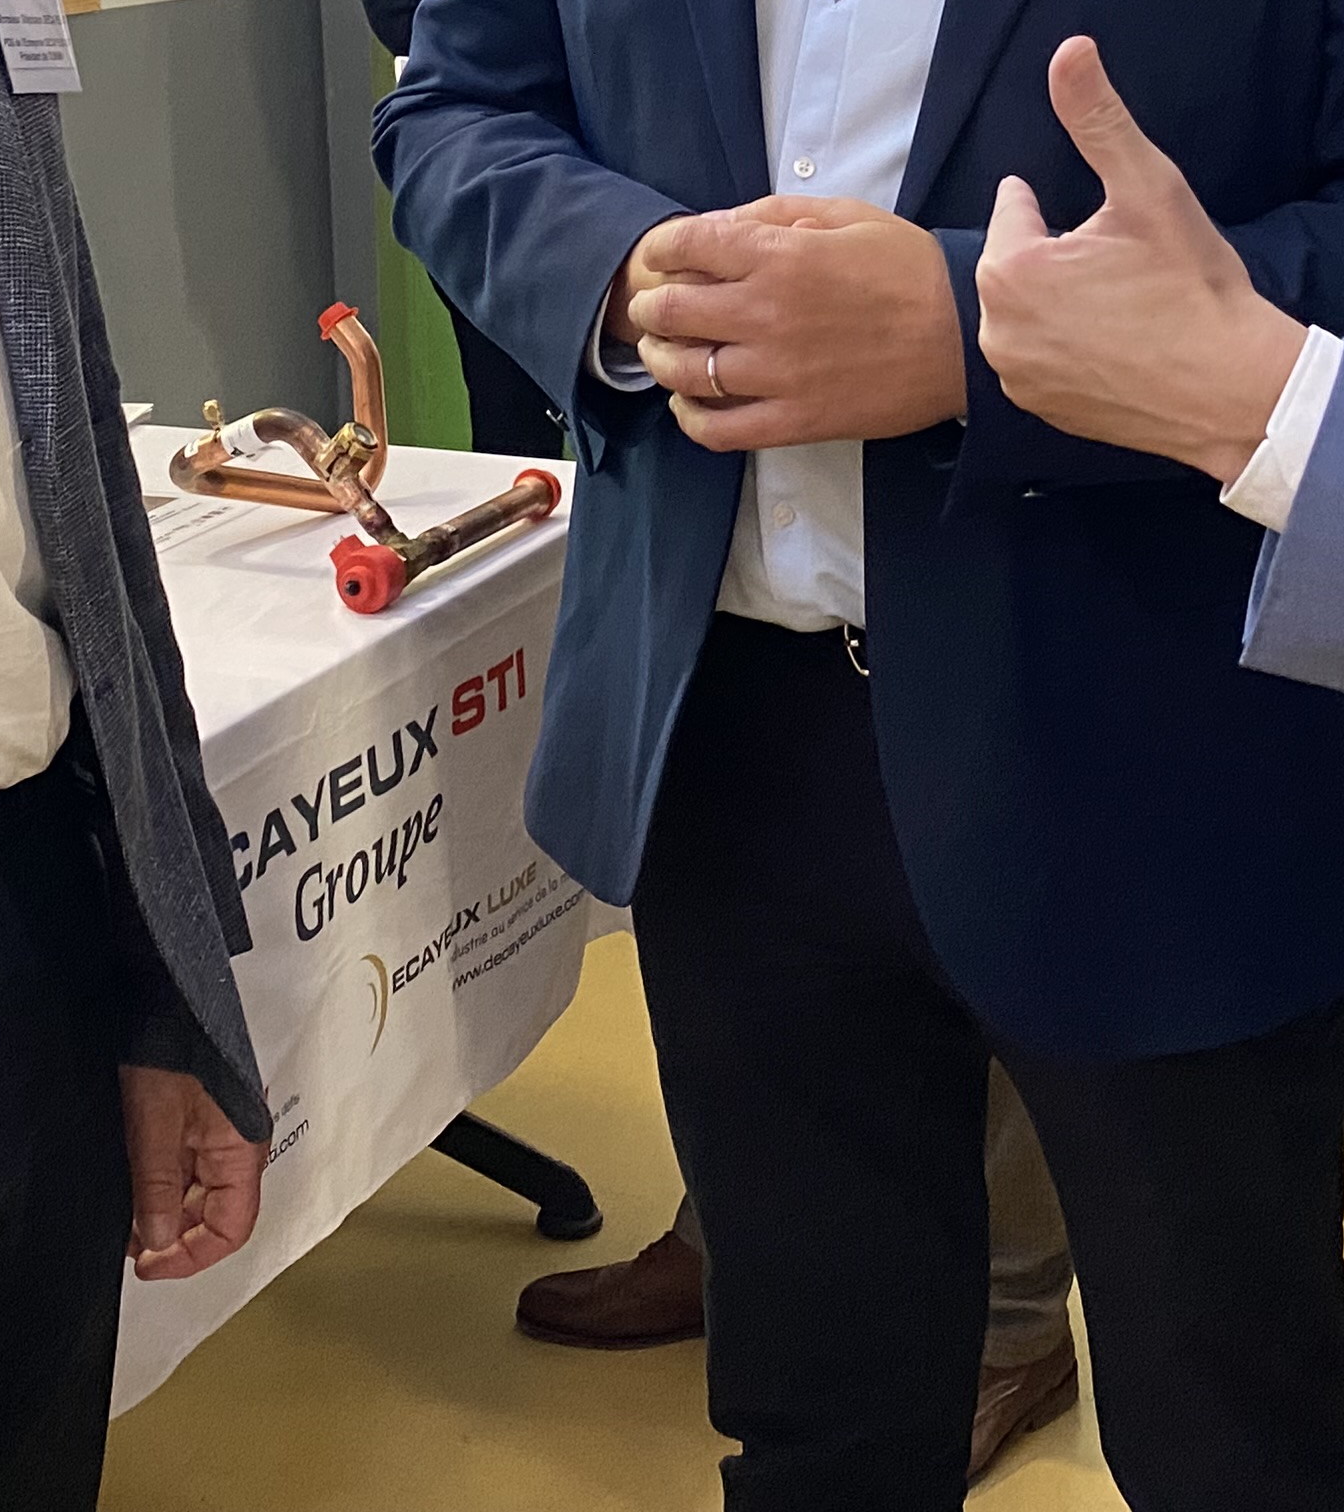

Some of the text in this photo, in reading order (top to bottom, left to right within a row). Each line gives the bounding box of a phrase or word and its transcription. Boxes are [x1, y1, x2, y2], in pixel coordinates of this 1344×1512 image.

[451, 647, 526, 737] STI
[295, 793, 443, 942] Groupe
[487, 861, 537, 915] LUXE
